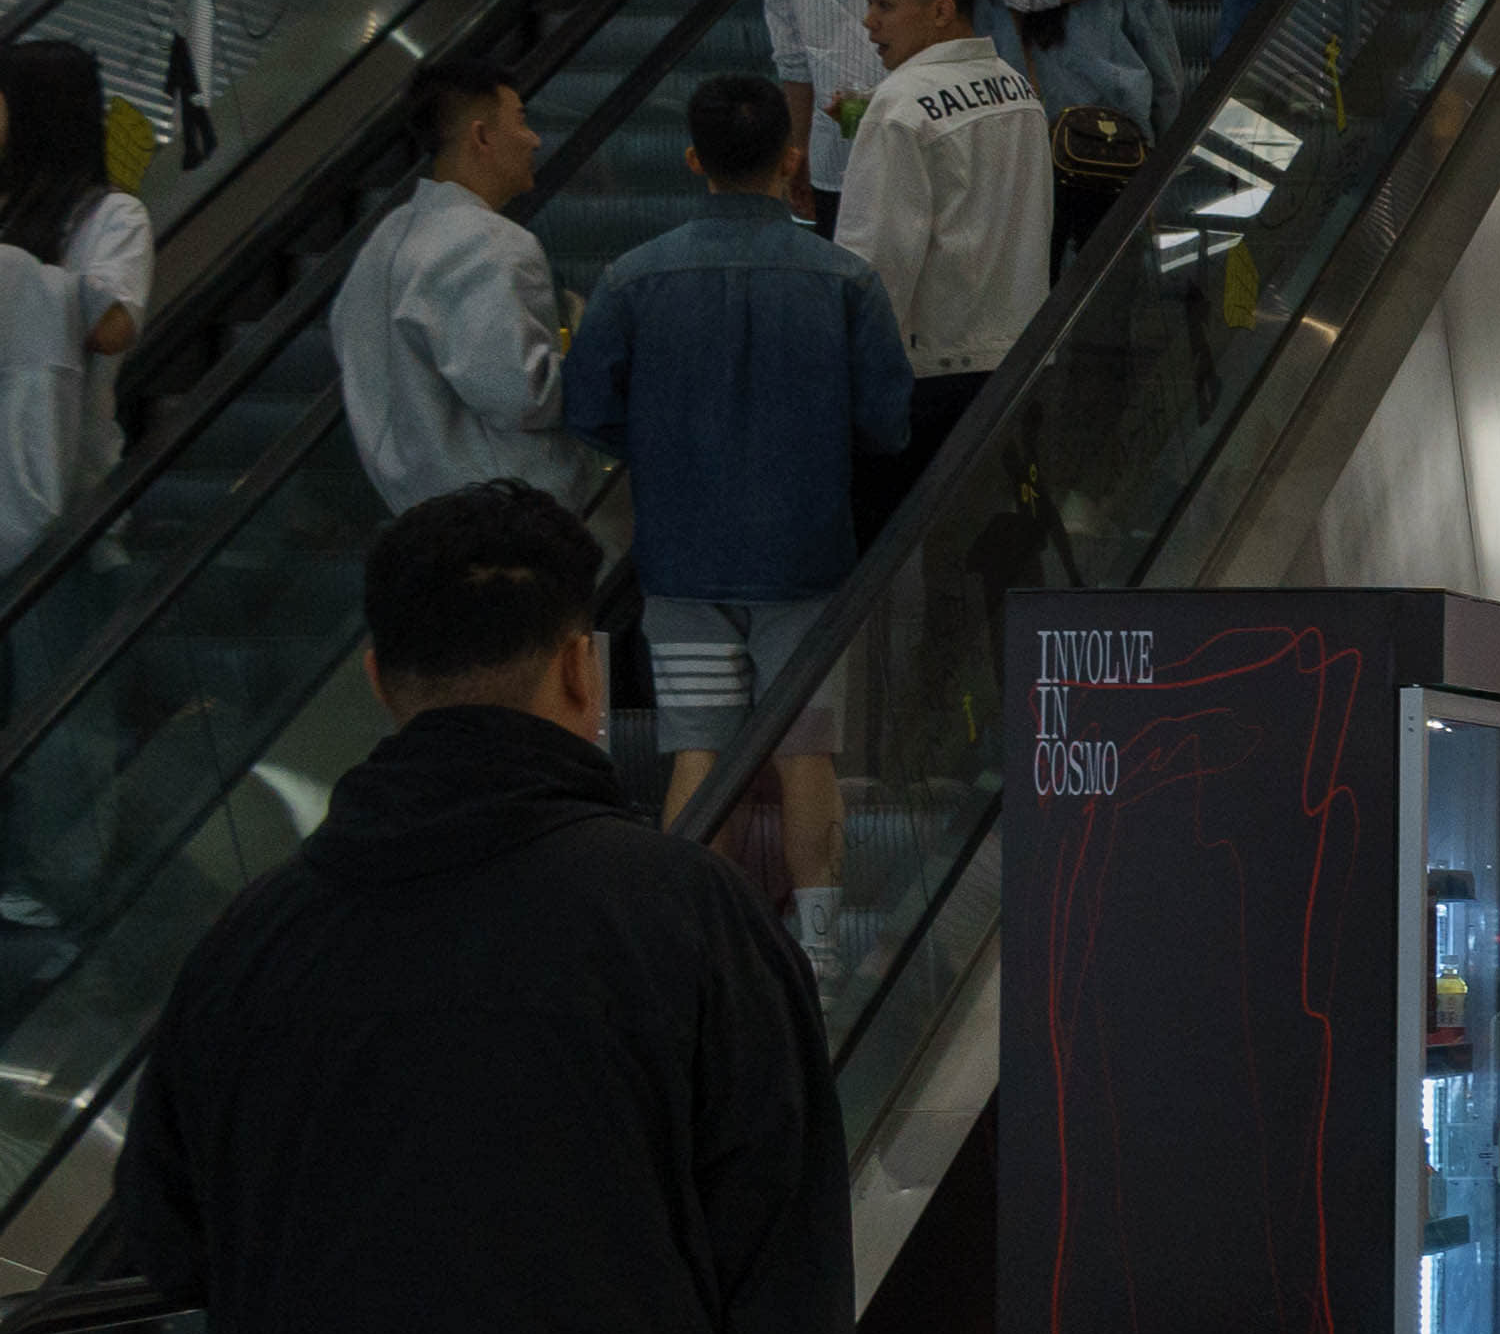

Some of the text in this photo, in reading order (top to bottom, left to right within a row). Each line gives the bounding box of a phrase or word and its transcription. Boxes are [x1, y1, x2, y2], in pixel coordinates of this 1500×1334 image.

[1036, 629, 1154, 685] INVOLVE
[1035, 685, 1069, 740] IN
[1034, 740, 1119, 796] COSMO
